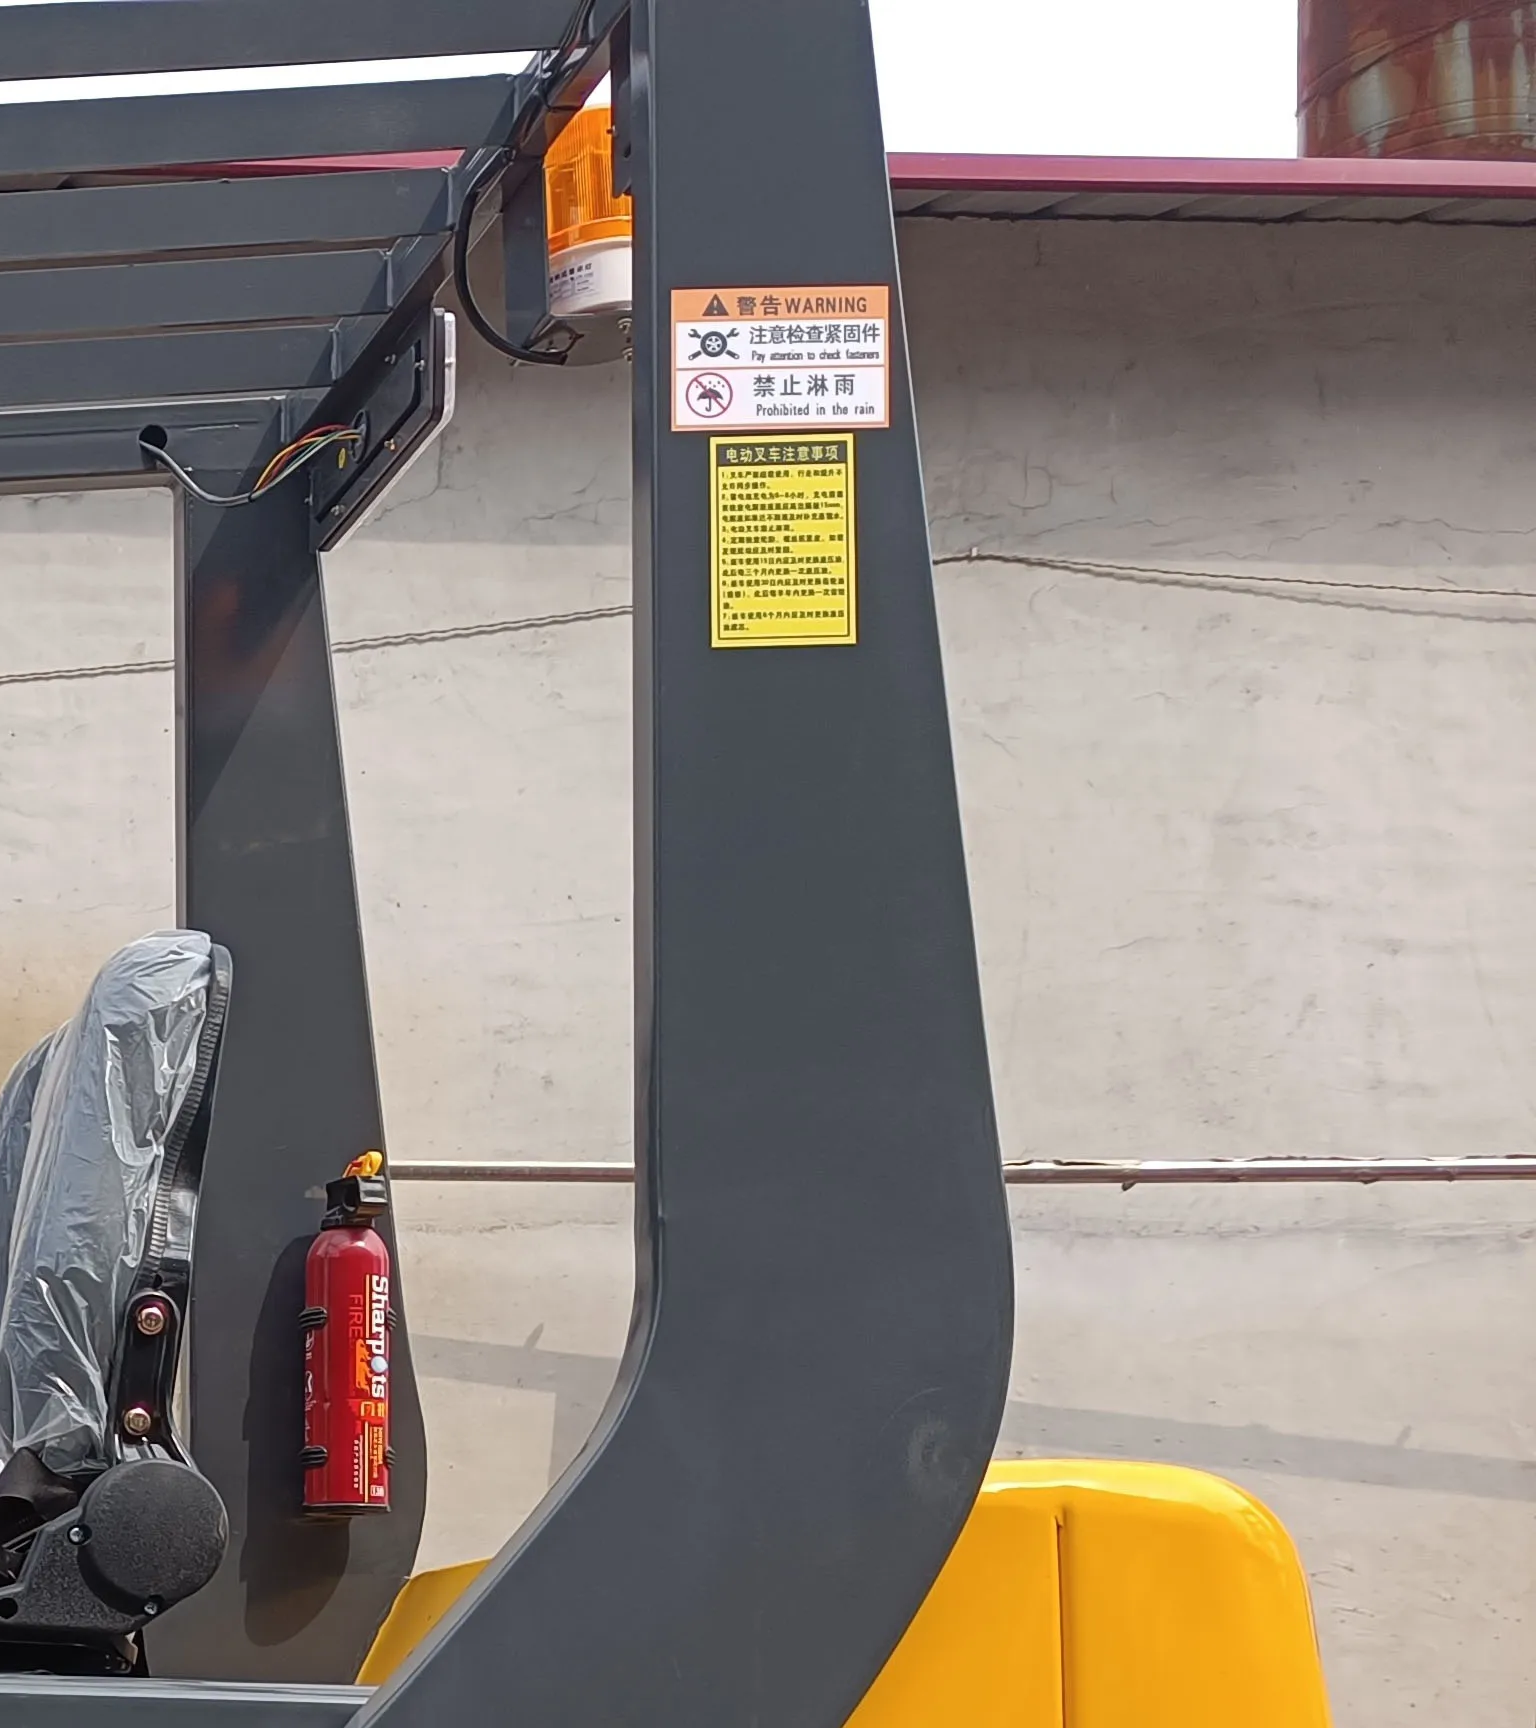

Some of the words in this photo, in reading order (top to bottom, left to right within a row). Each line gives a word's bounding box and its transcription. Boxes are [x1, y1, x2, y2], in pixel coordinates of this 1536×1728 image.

[736, 295, 781, 317] 警告
[784, 296, 868, 315] WARNING
[749, 323, 881, 345] 注意检查紧固件
[751, 350, 766, 363] Pay
[807, 350, 816, 360] to
[819, 349, 841, 360] check
[753, 374, 856, 398] 禁止淋雨
[756, 403, 810, 417] Prohibited
[816, 402, 826, 416] in
[832, 402, 848, 416] the
[854, 402, 875, 415] rain
[725, 444, 840, 463] 电动叉车注意事项
[349, 1294, 364, 1339] FIRE
